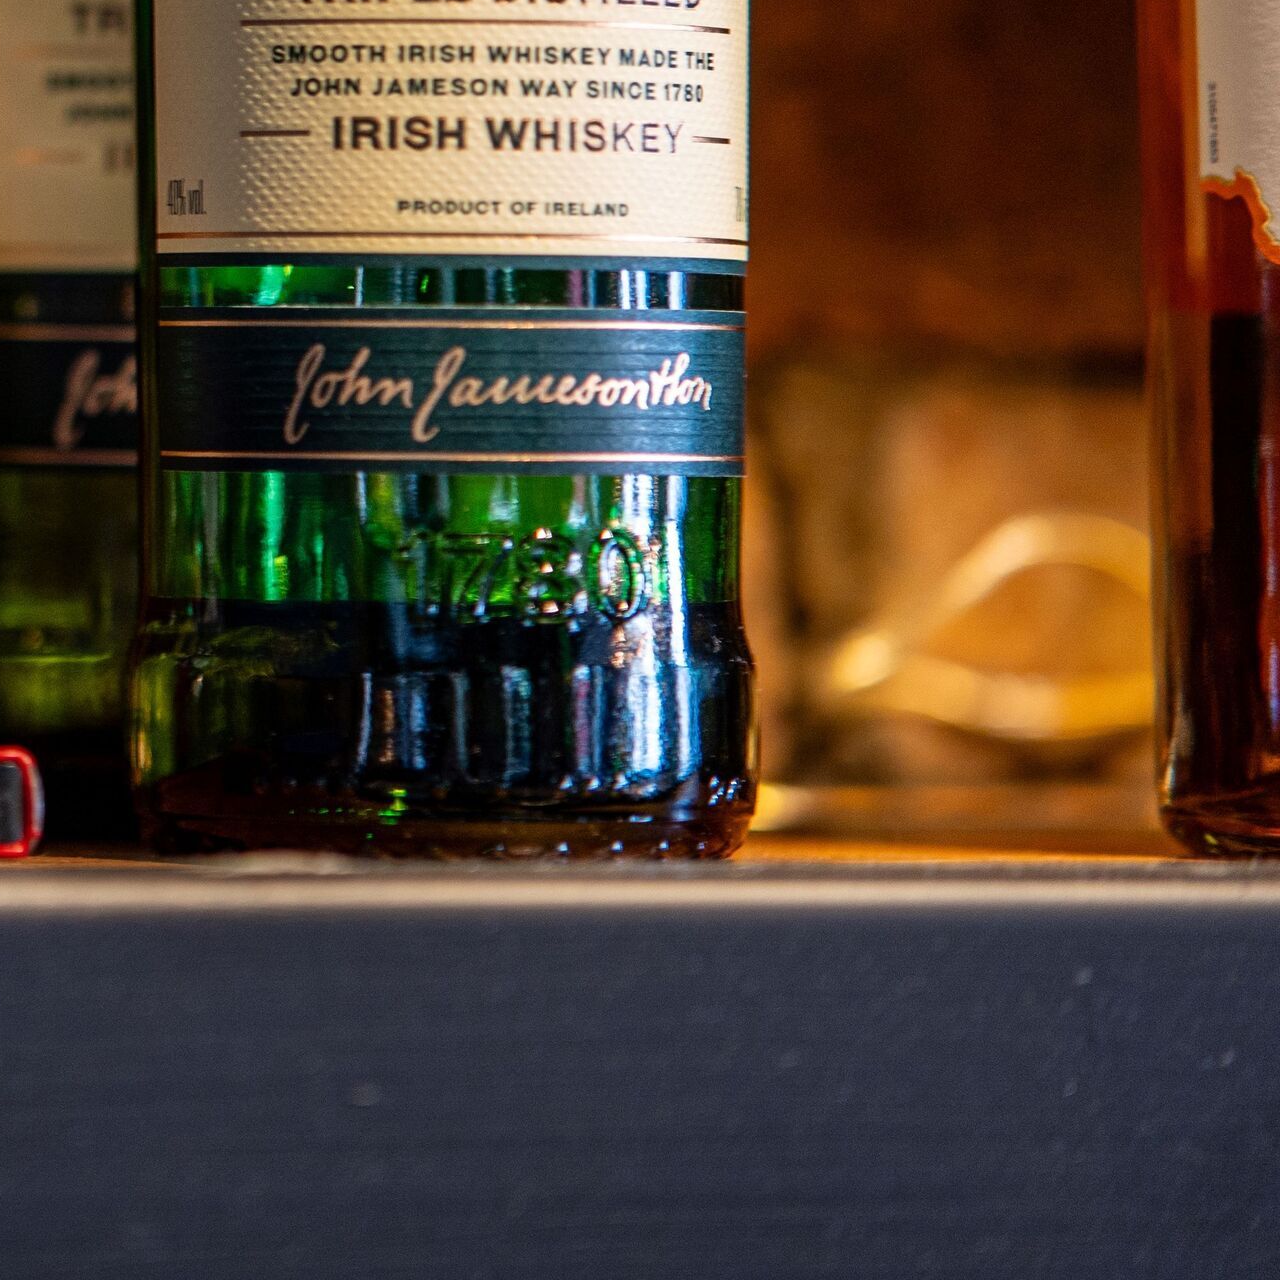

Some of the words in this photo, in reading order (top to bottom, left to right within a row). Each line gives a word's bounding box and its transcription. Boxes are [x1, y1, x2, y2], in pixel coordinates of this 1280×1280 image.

[271, 44, 386, 64] SMOOTH
[397, 44, 475, 64] IRISH
[486, 45, 610, 66] WHISKEY
[619, 48, 679, 69] MADE
[684, 51, 716, 71] THE
[291, 78, 362, 97] JOHN
[373, 78, 509, 97] JAMESON
[520, 79, 577, 98] WAY
[586, 80, 656, 101] SINCE
[663, 83, 704, 103] 1780
[332, 116, 466, 152] IRISH
[485, 117, 684, 154] WHISKEY
[396, 201, 501, 217] PRODUCT
[510, 201, 537, 216] OF
[545, 202, 630, 218] IRELAND
[283, 342, 413, 445] John
